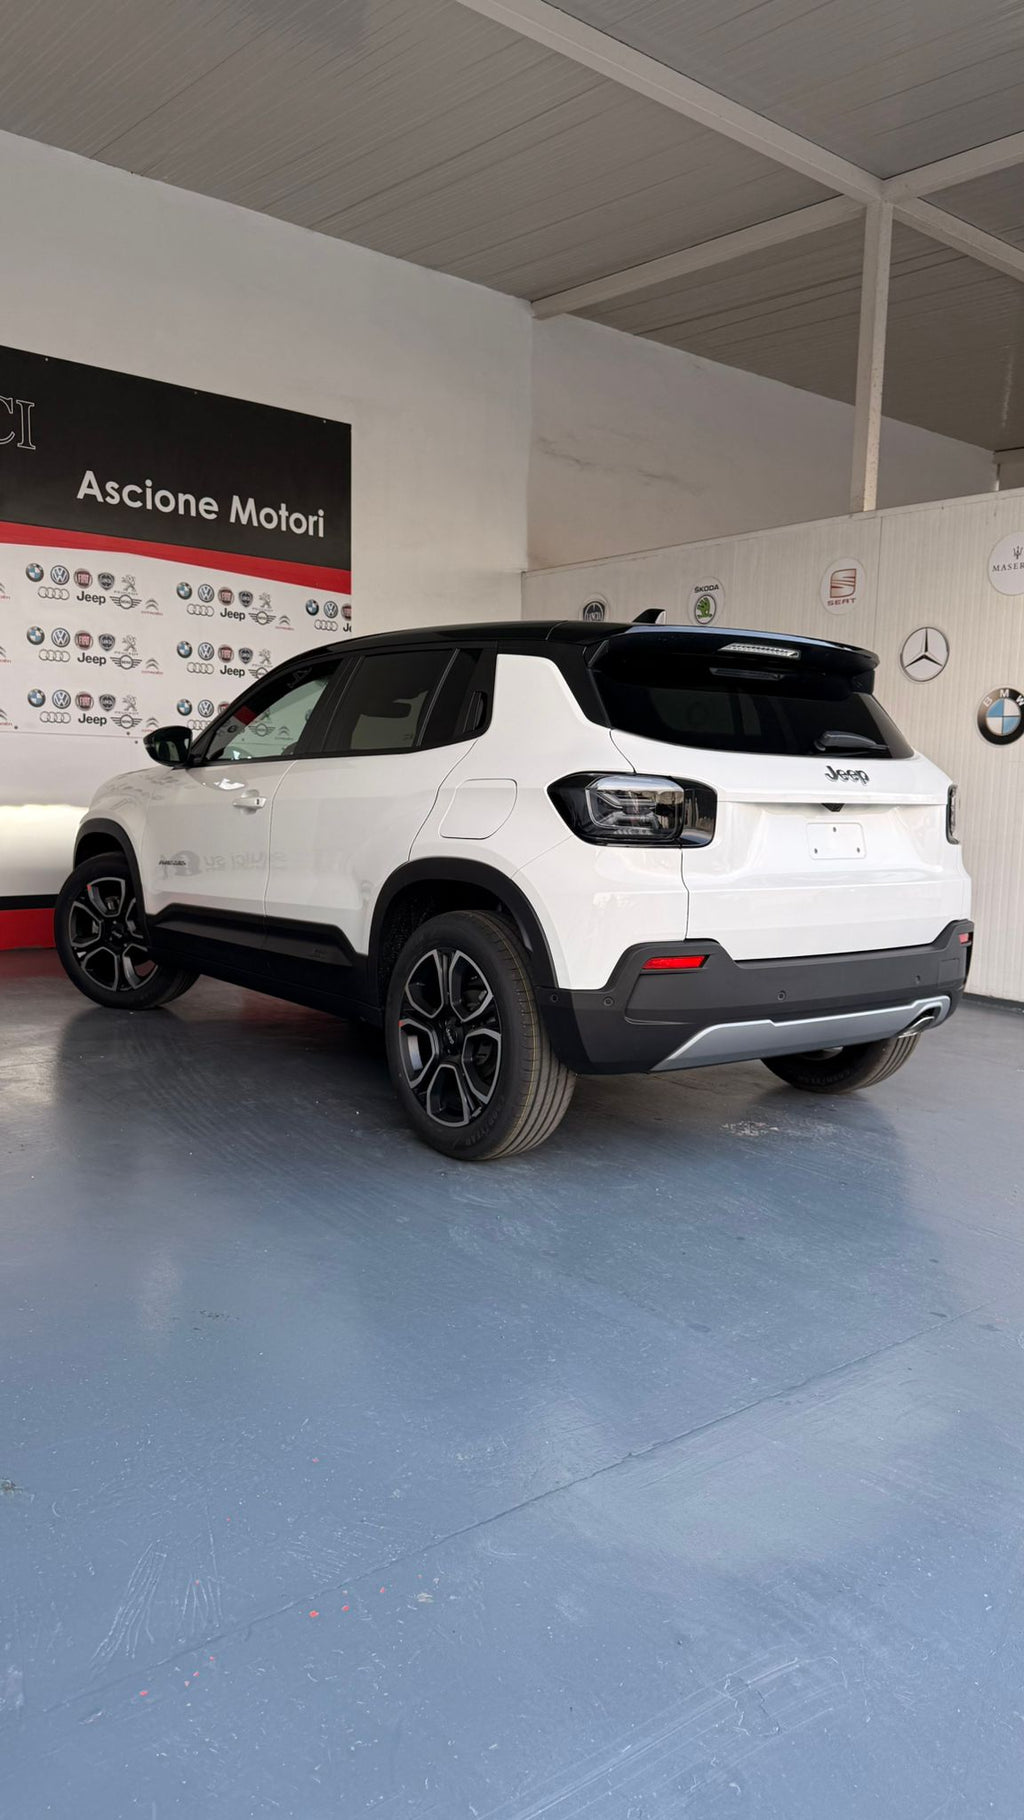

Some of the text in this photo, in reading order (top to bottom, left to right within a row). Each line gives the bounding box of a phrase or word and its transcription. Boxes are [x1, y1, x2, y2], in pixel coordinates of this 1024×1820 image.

[76, 469, 326, 538] Ascione Motori
[76, 590, 107, 606] Jeep
[827, 597, 856, 607] SEAT
[220, 607, 246, 621] Jeep
[77, 652, 107, 667] Jeep
[220, 664, 246, 678] Jeep
[78, 713, 108, 727] Jeep
[824, 765, 870, 785] Jeep
